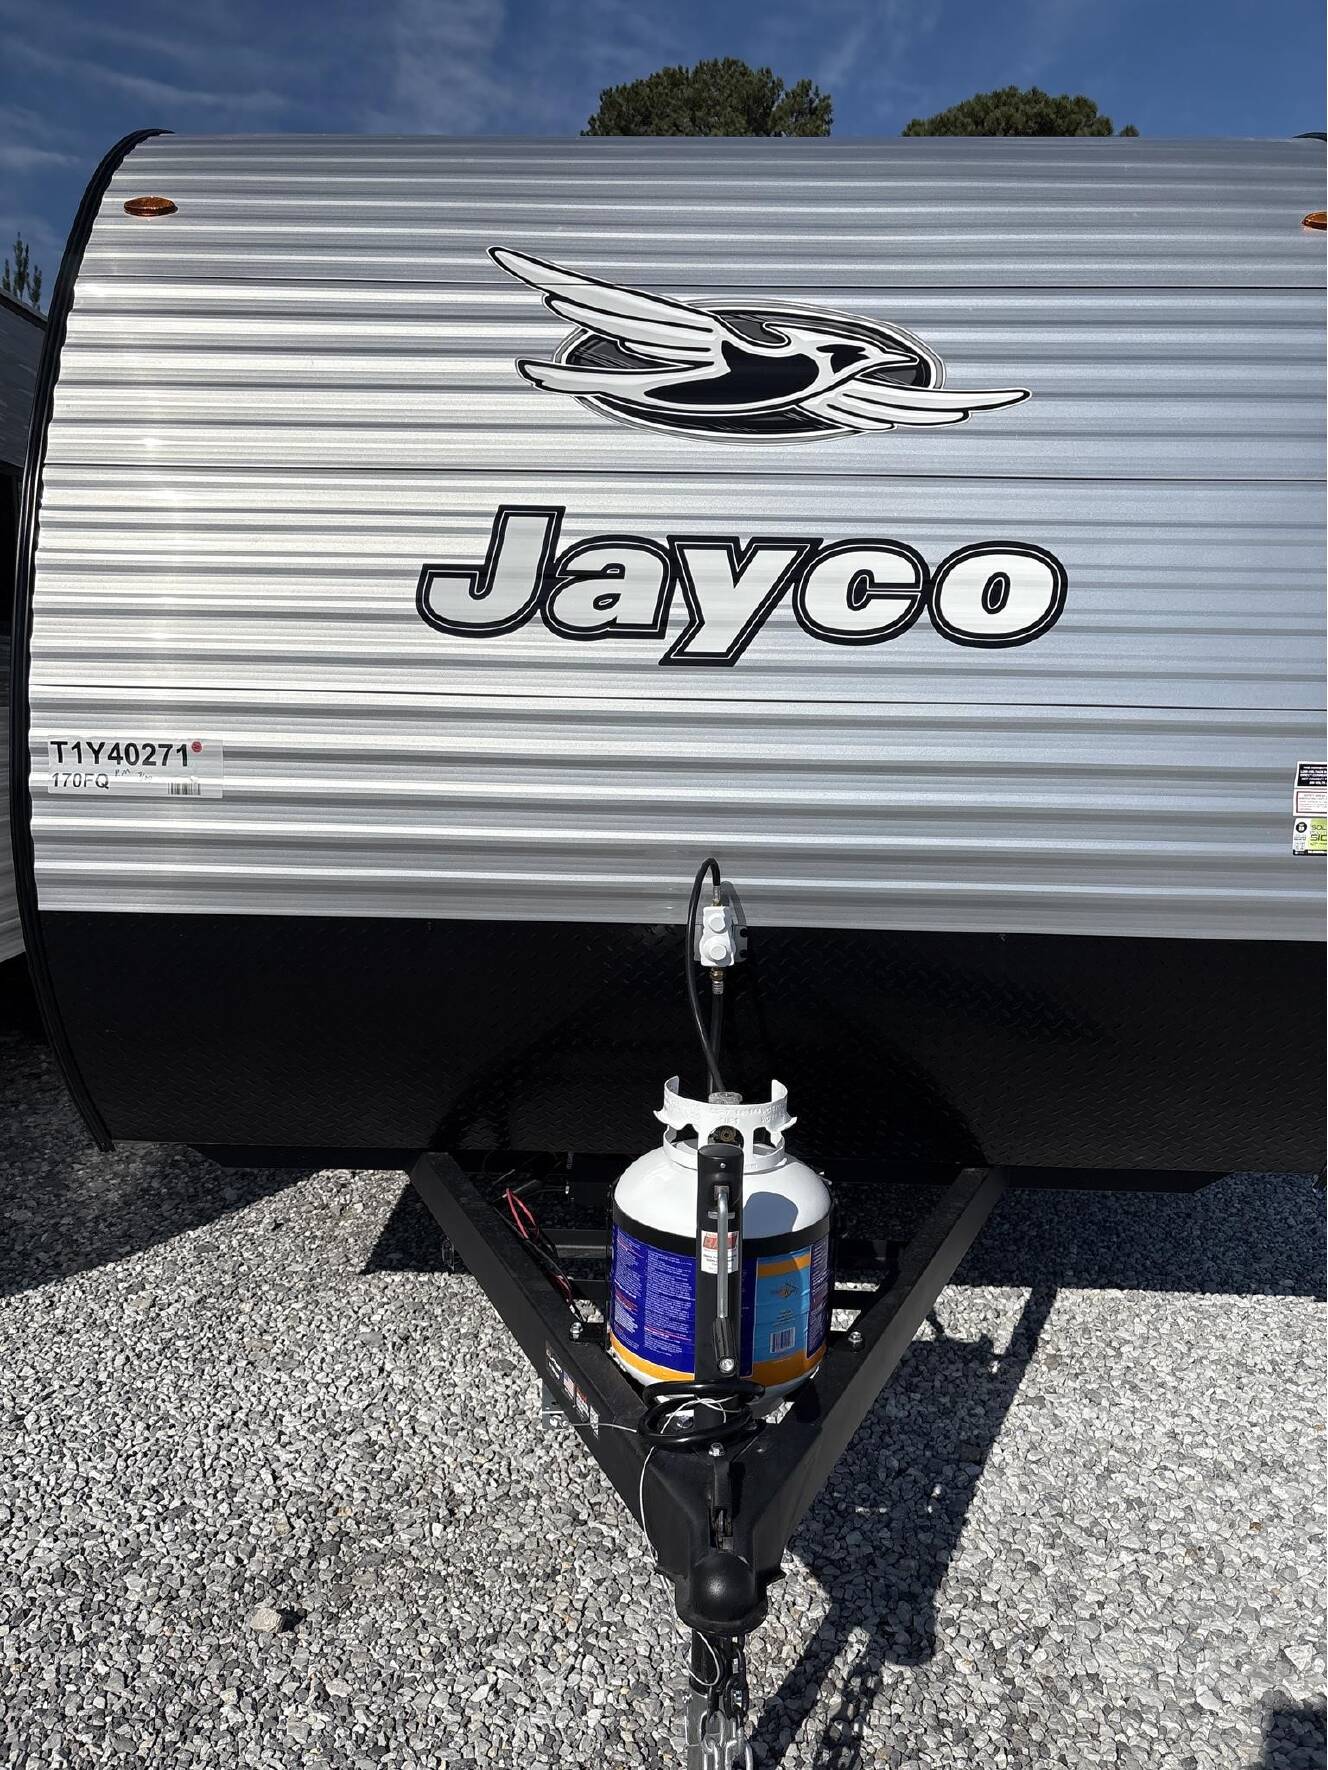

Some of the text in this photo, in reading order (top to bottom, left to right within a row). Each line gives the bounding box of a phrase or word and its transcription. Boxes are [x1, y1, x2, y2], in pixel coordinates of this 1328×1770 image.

[416, 504, 1068, 667] Jayco
[50, 741, 188, 767] T1Y40271
[52, 773, 109, 789] 170FQ
